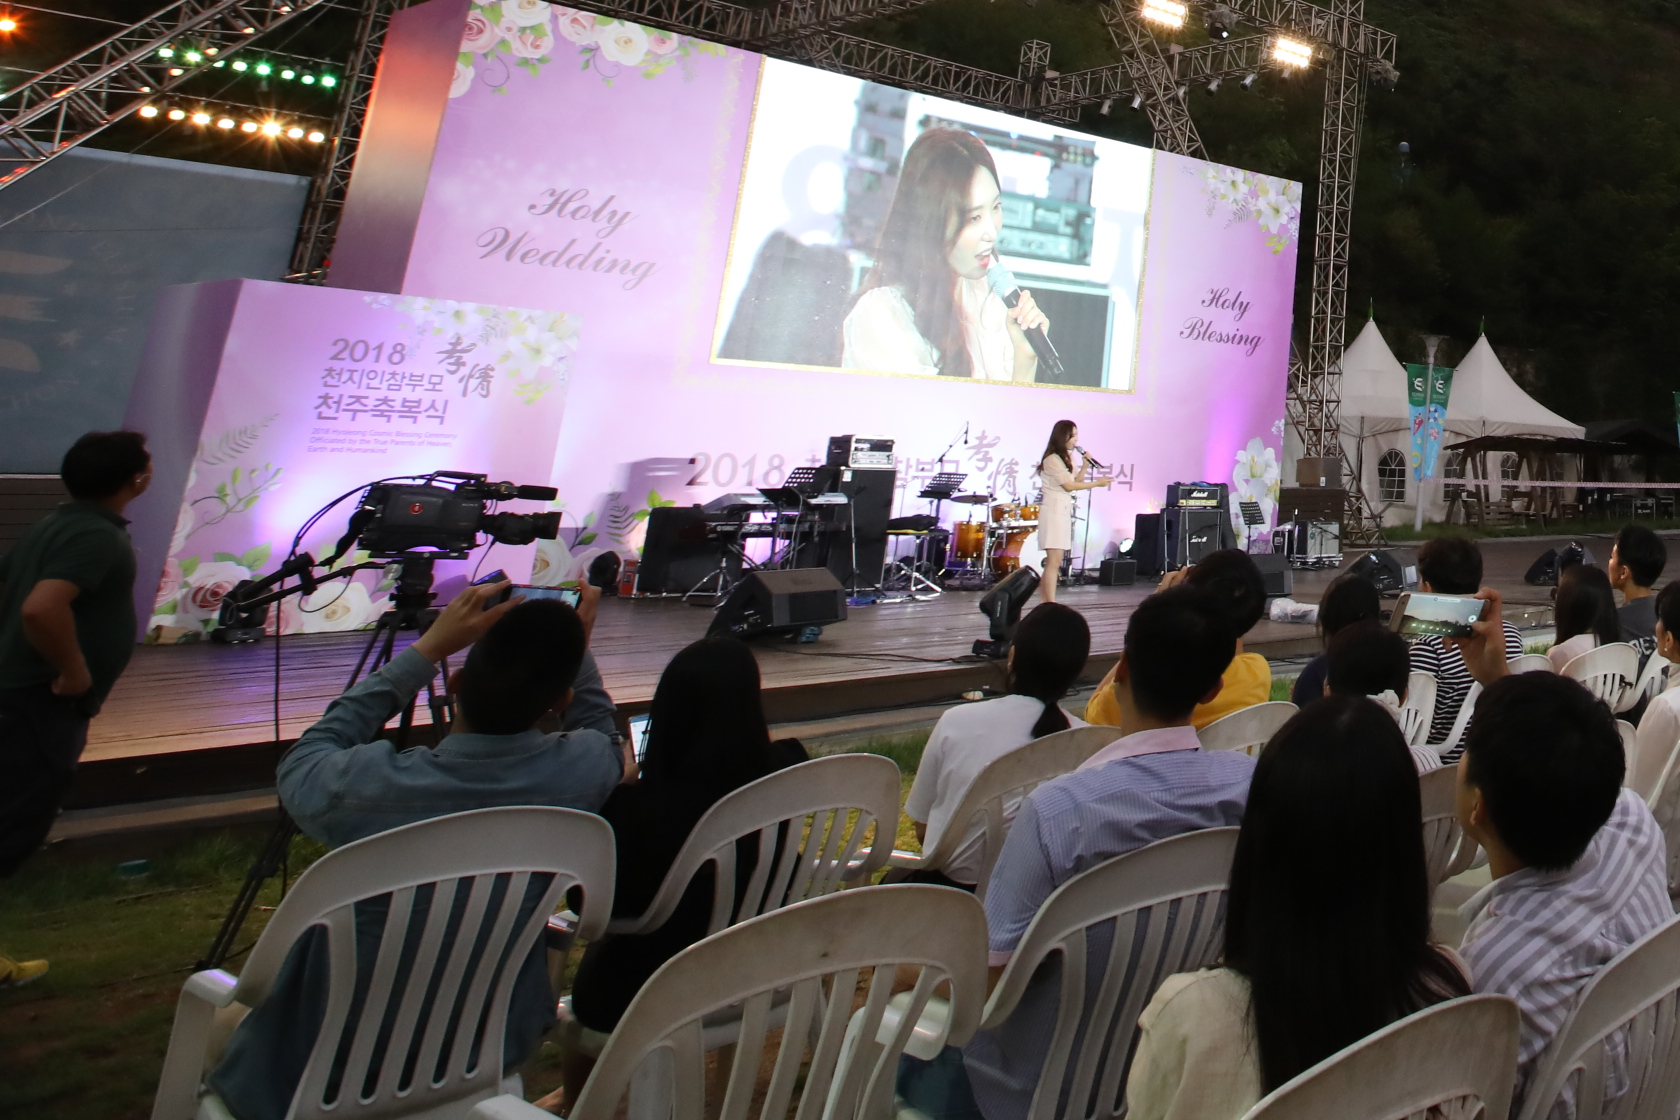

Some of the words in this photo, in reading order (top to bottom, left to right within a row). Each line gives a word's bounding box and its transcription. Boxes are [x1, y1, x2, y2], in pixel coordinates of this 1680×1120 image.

[528, 188, 640, 239] Holy
[476, 226, 664, 291] Wedding
[1200, 287, 1254, 322] Holy
[329, 338, 406, 365] 2018
[1179, 316, 1265, 357] Blessing
[321, 366, 444, 392] 천지인참부모
[313, 392, 449, 425] 천주축복식
[307, 445, 328, 453] Earth
[346, 446, 388, 454] Humankind
[309, 436, 346, 444] Officiated
[348, 437, 358, 446] by
[417, 439, 426, 447] of
[311, 427, 331, 435] 2018
[369, 429, 394, 437] Cosmic
[395, 430, 423, 439] Blessing
[424, 432, 458, 440] Ceremony
[687, 451, 784, 487] 2018
